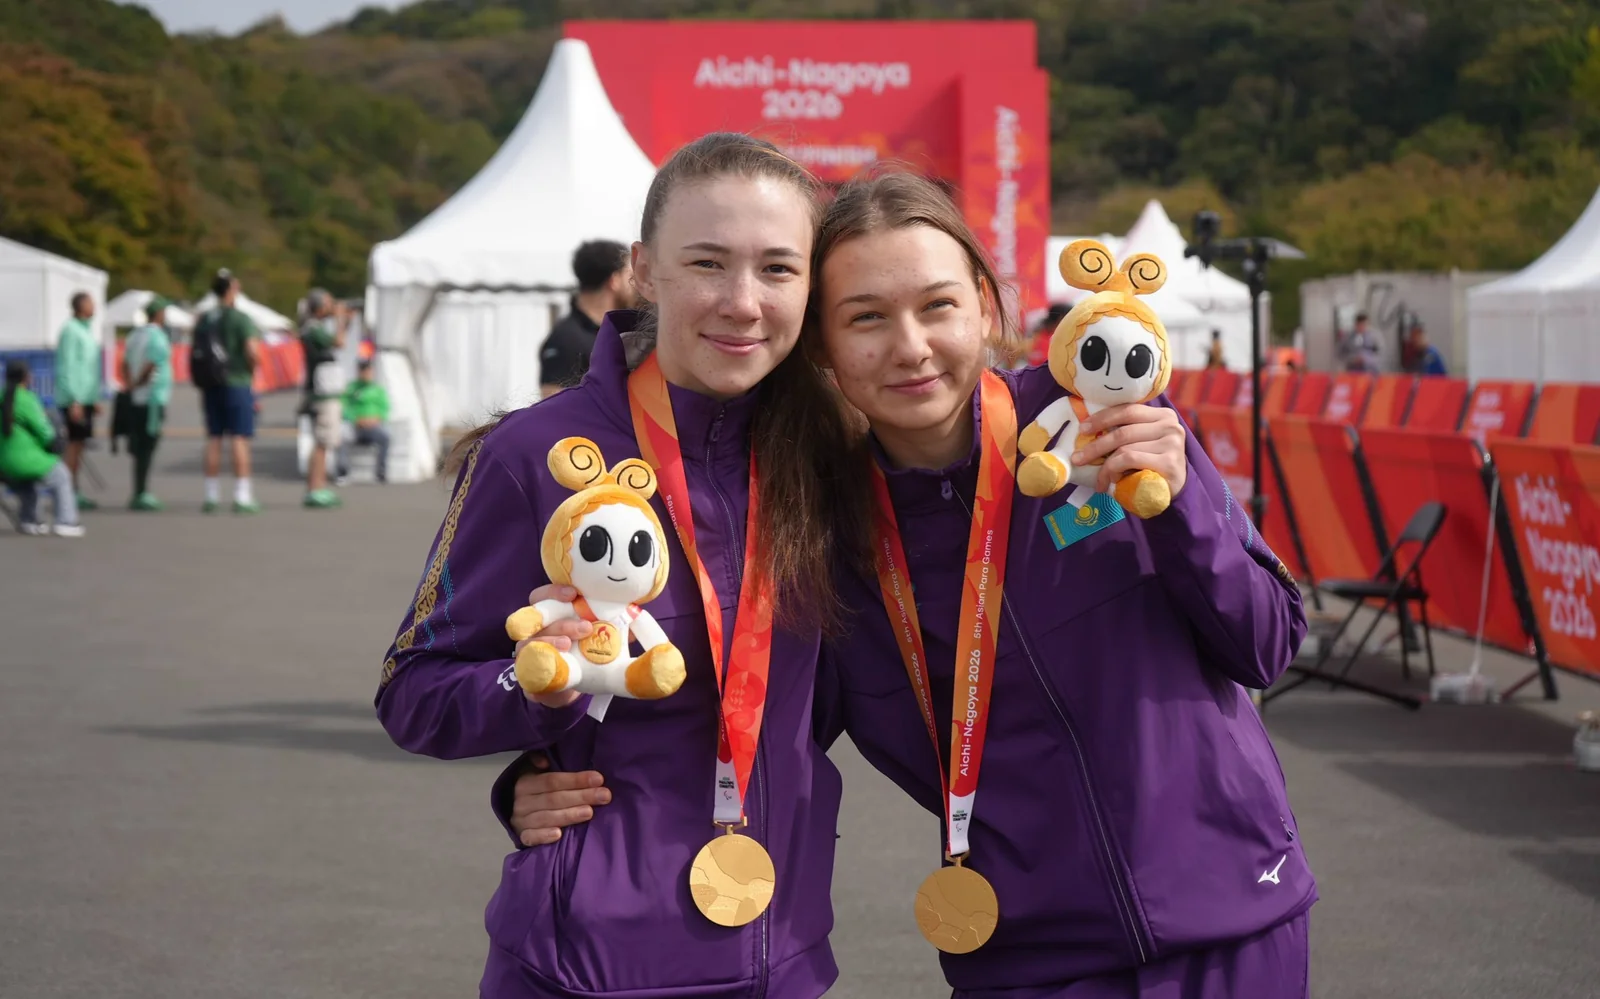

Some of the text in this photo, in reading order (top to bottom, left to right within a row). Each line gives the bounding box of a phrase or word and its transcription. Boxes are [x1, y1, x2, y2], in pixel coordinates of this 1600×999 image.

[695, 56, 909, 94] Aichi-Nagoya
[763, 90, 843, 118] 2026
[982, 529, 994, 565] Games
[892, 573, 901, 596] Para
[979, 567, 989, 590] Para
[898, 599, 908, 624] Asian
[976, 592, 985, 619] Asian
[911, 652, 923, 685] 2026
[960, 649, 981, 776] Aichi-Nagoya 2026
